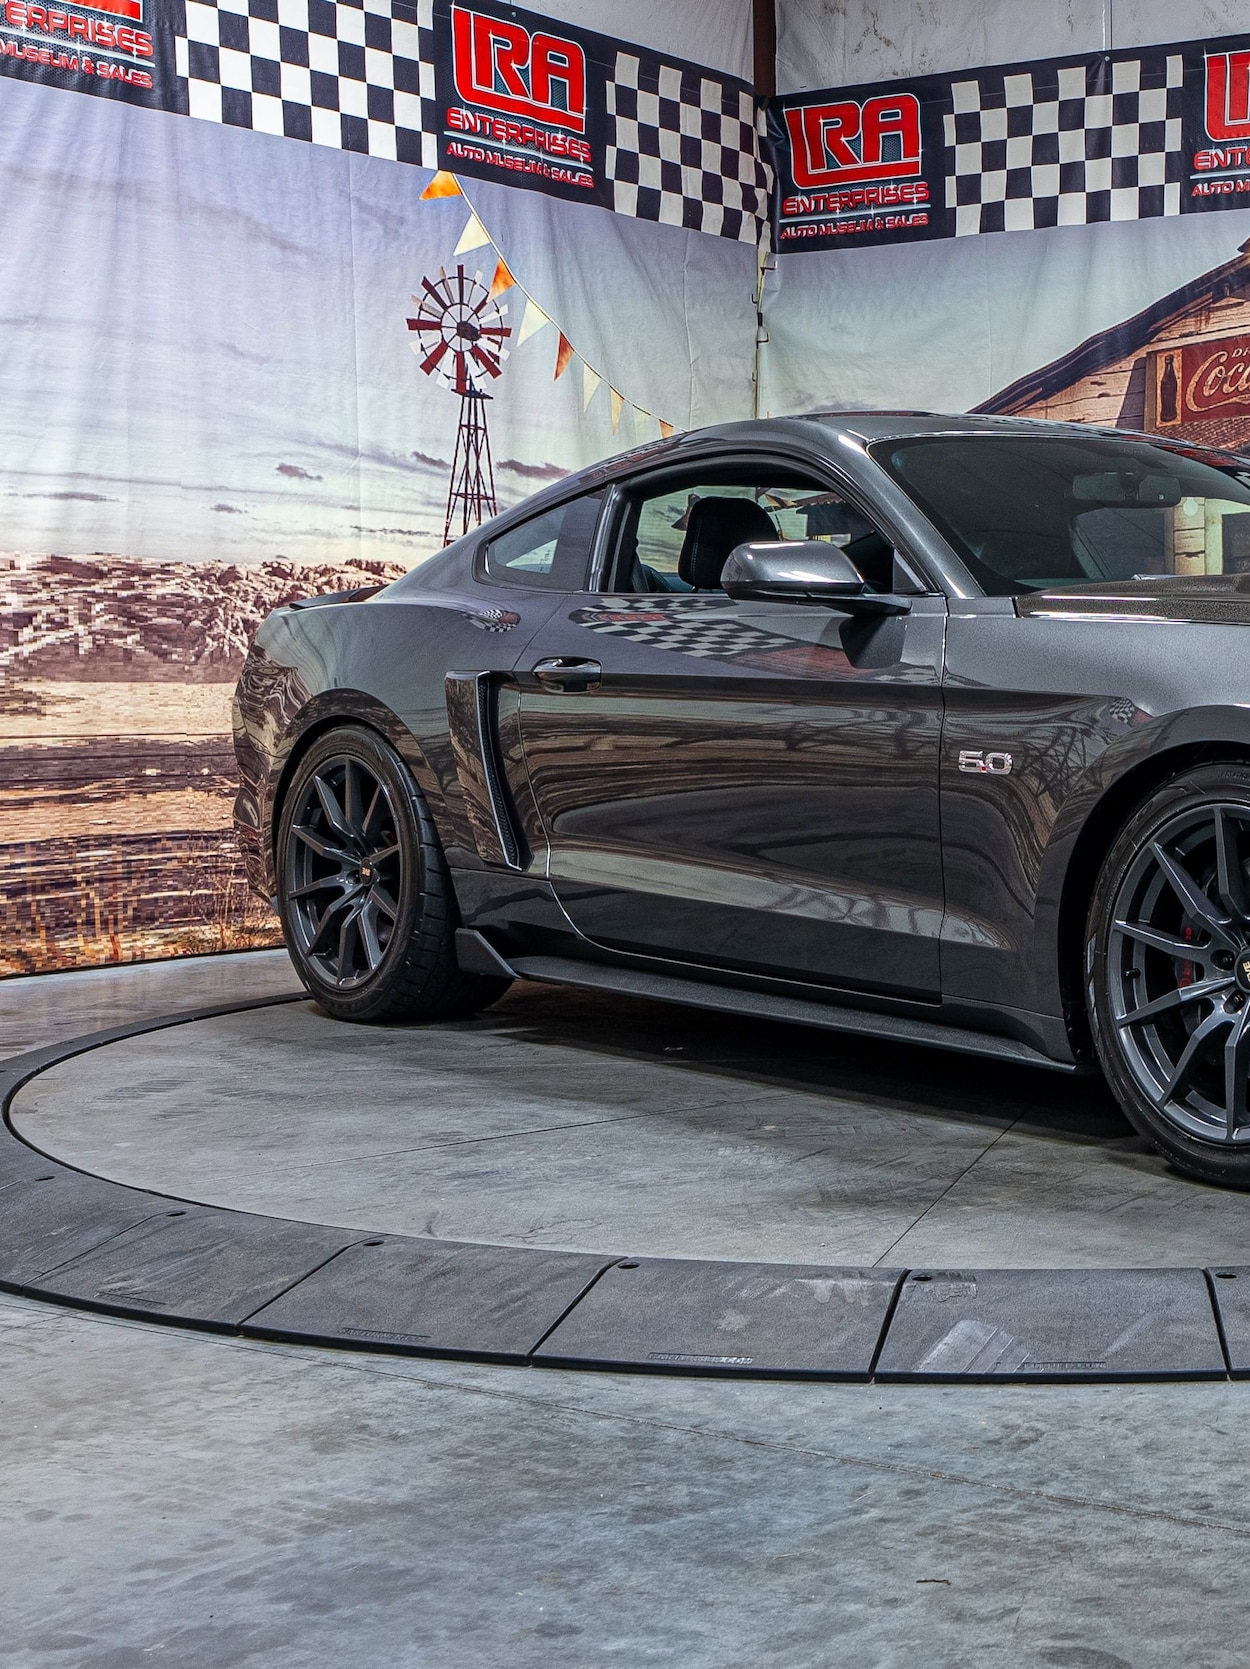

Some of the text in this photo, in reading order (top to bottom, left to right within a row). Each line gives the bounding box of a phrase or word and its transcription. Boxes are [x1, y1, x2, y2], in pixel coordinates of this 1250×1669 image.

[0, 0, 154, 57] ERPRISES
[0, 38, 153, 89] MUSEUM & SALES
[446, 107, 592, 162] ENTERPRISES
[446, 142, 594, 188] AUTO MUSEUM & SALES
[783, 181, 930, 214] ENTERPRISES
[1192, 181, 1234, 197] AUTO
[780, 213, 929, 239] AUTO MUSEUM & SALES
